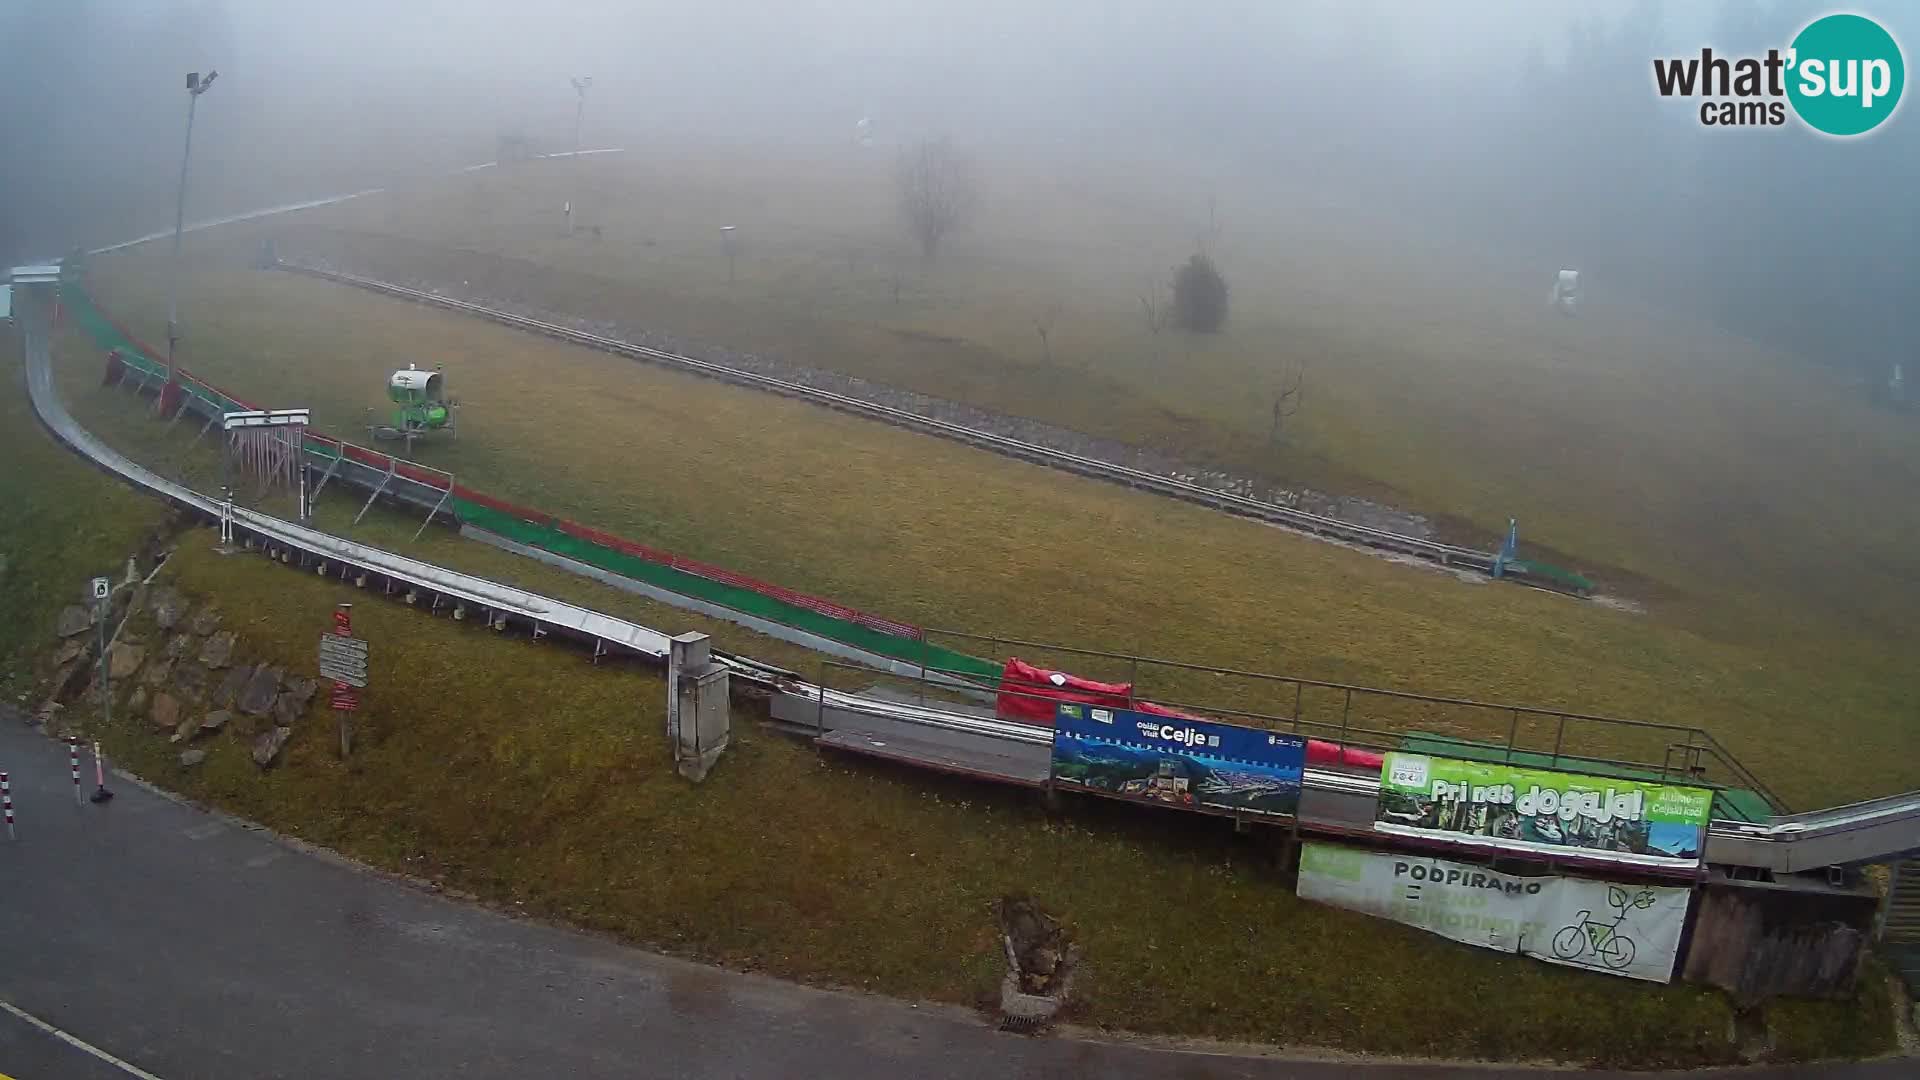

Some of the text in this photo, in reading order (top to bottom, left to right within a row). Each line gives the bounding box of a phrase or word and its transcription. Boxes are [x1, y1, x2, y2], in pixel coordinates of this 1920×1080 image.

[1142, 729, 1159, 738] Visit
[1160, 725, 1206, 747] Celje
[1431, 779, 1468, 802] Pri
[1472, 784, 1515, 804] nas
[1394, 861, 1541, 895] PODPIRAMO
